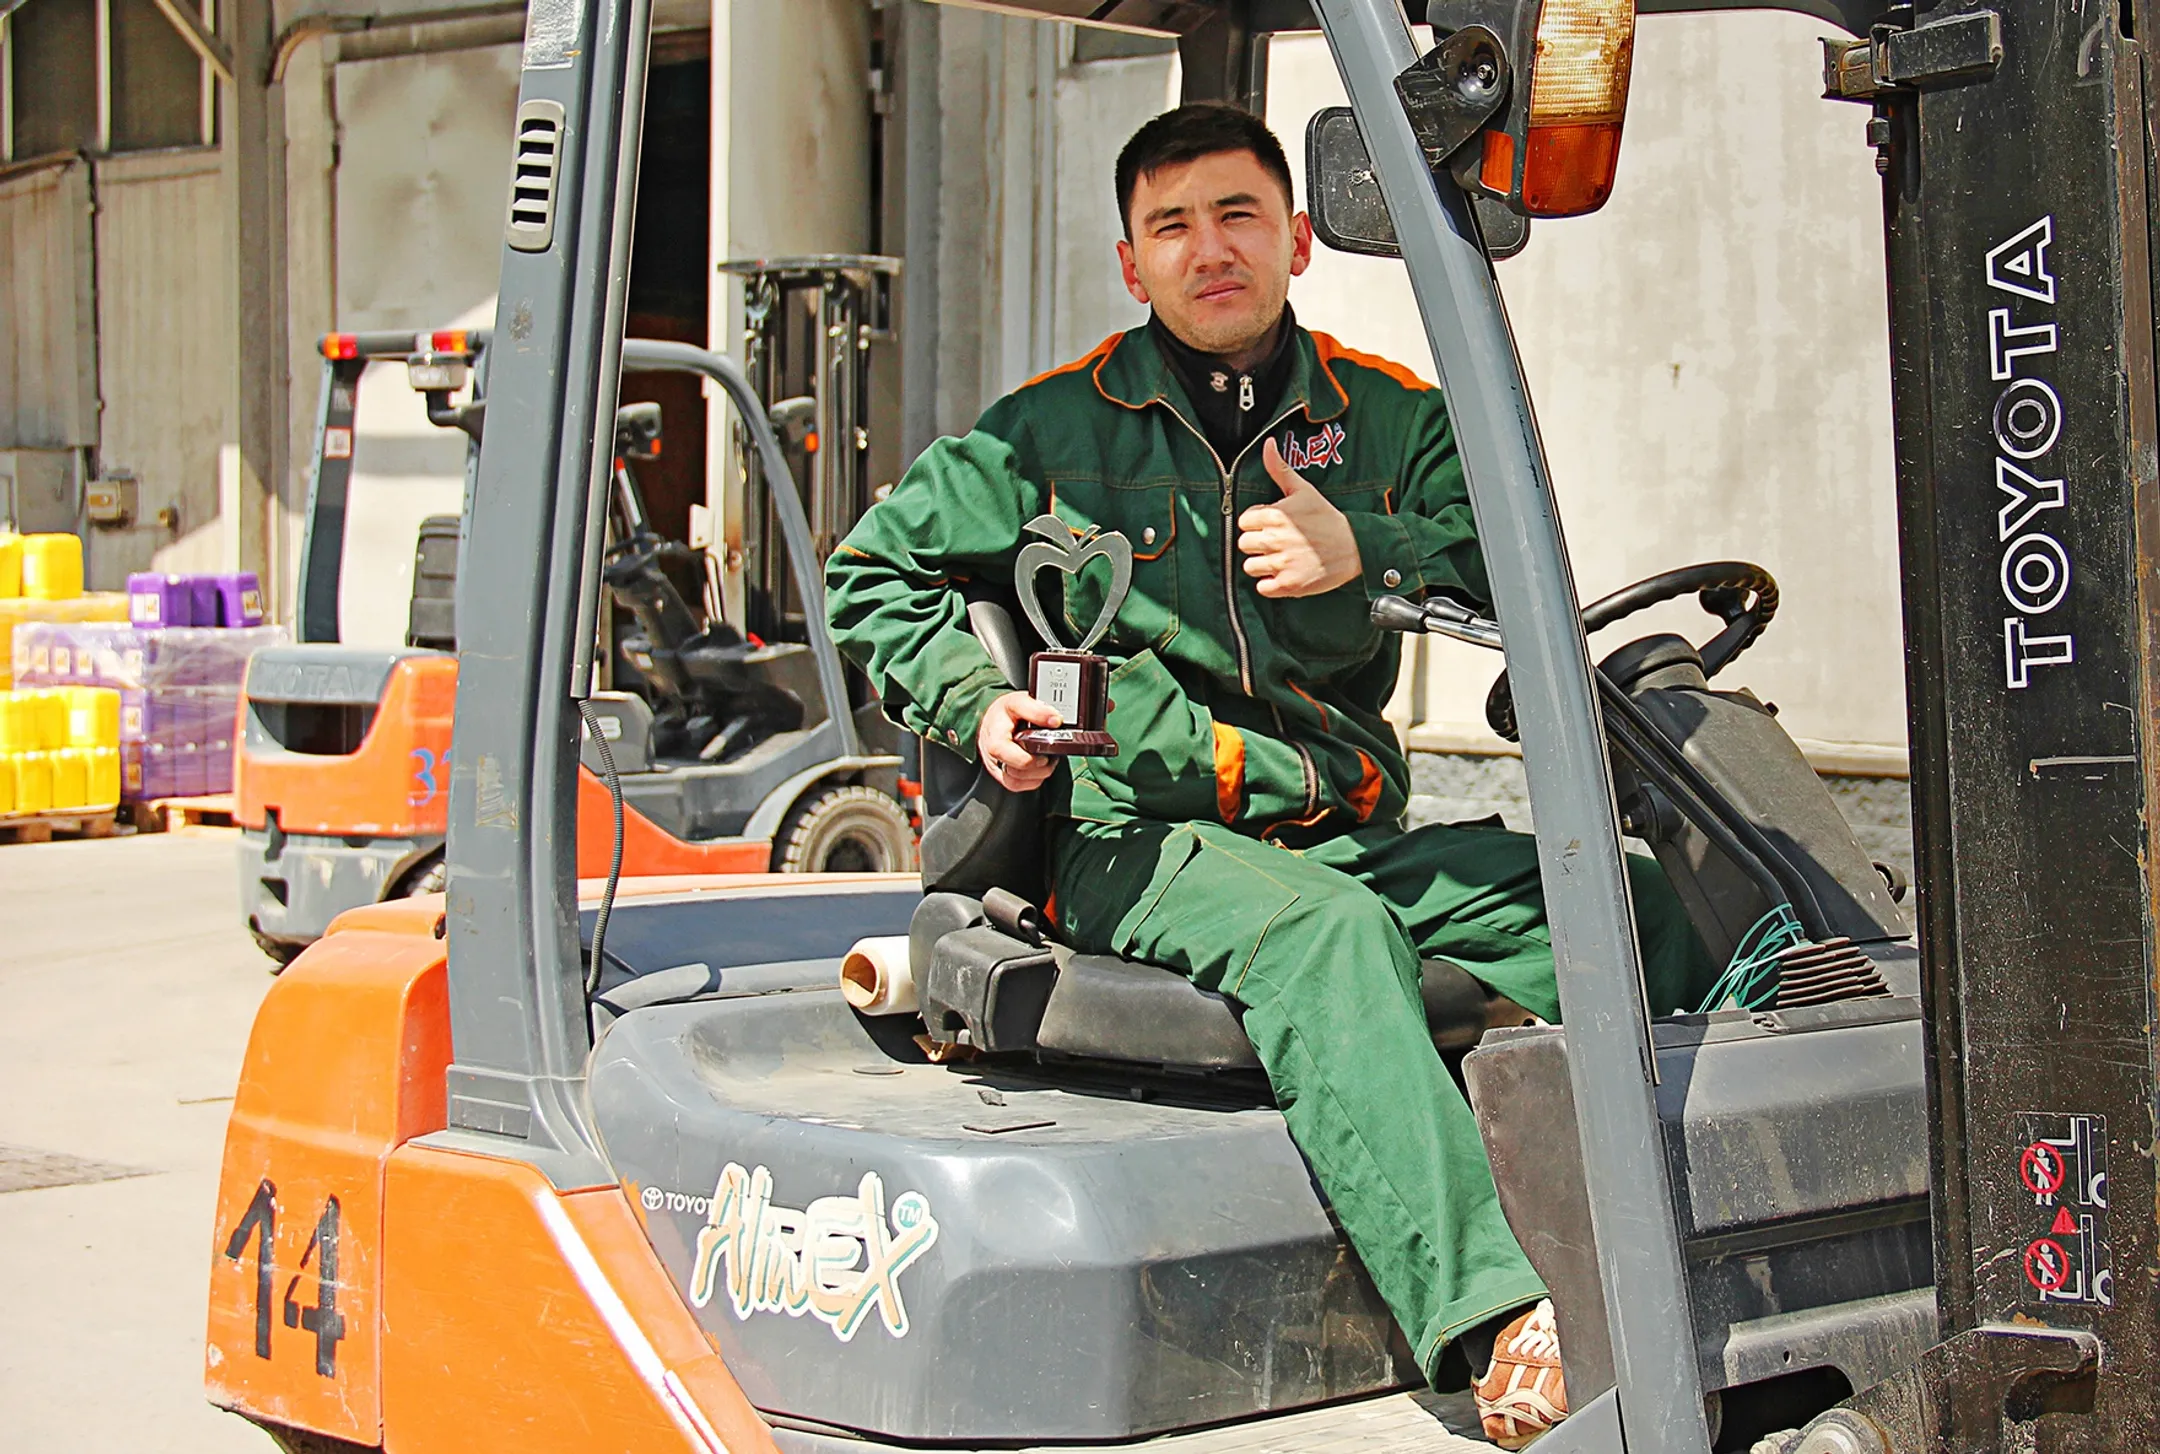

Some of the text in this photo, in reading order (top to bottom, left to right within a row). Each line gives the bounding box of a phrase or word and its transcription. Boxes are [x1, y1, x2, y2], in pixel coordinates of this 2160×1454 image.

[1986, 214, 2073, 689] TOYOTA
[407, 747, 451, 807] 3
[665, 1192, 715, 1216] TOYOT
[225, 1178, 346, 1379] 14
